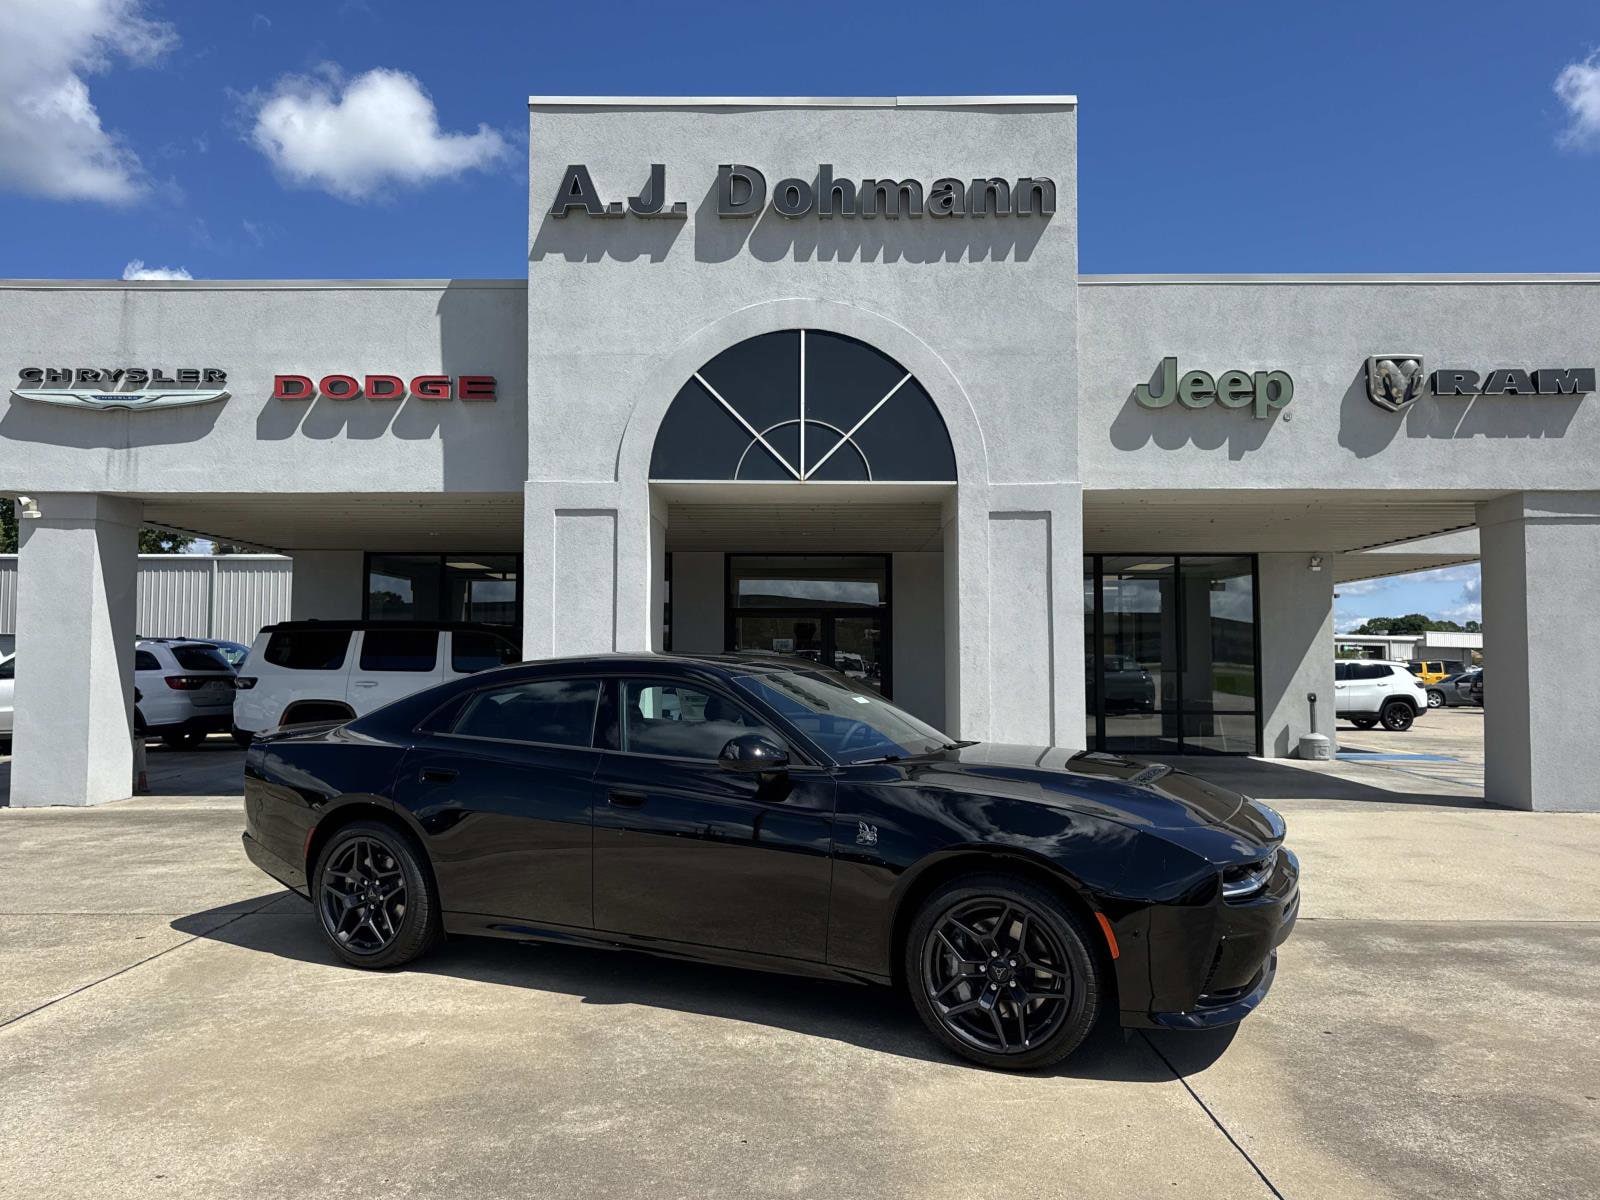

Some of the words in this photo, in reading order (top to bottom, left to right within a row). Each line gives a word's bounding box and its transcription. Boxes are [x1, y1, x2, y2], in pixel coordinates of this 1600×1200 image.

[549, 163, 688, 218] A.J.
[717, 163, 1057, 219] Dohmann
[18, 367, 227, 383] CHRYSLER
[274, 375, 497, 402] DODGE
[1136, 357, 1294, 419] Jeep
[1431, 368, 1596, 396] RAM
